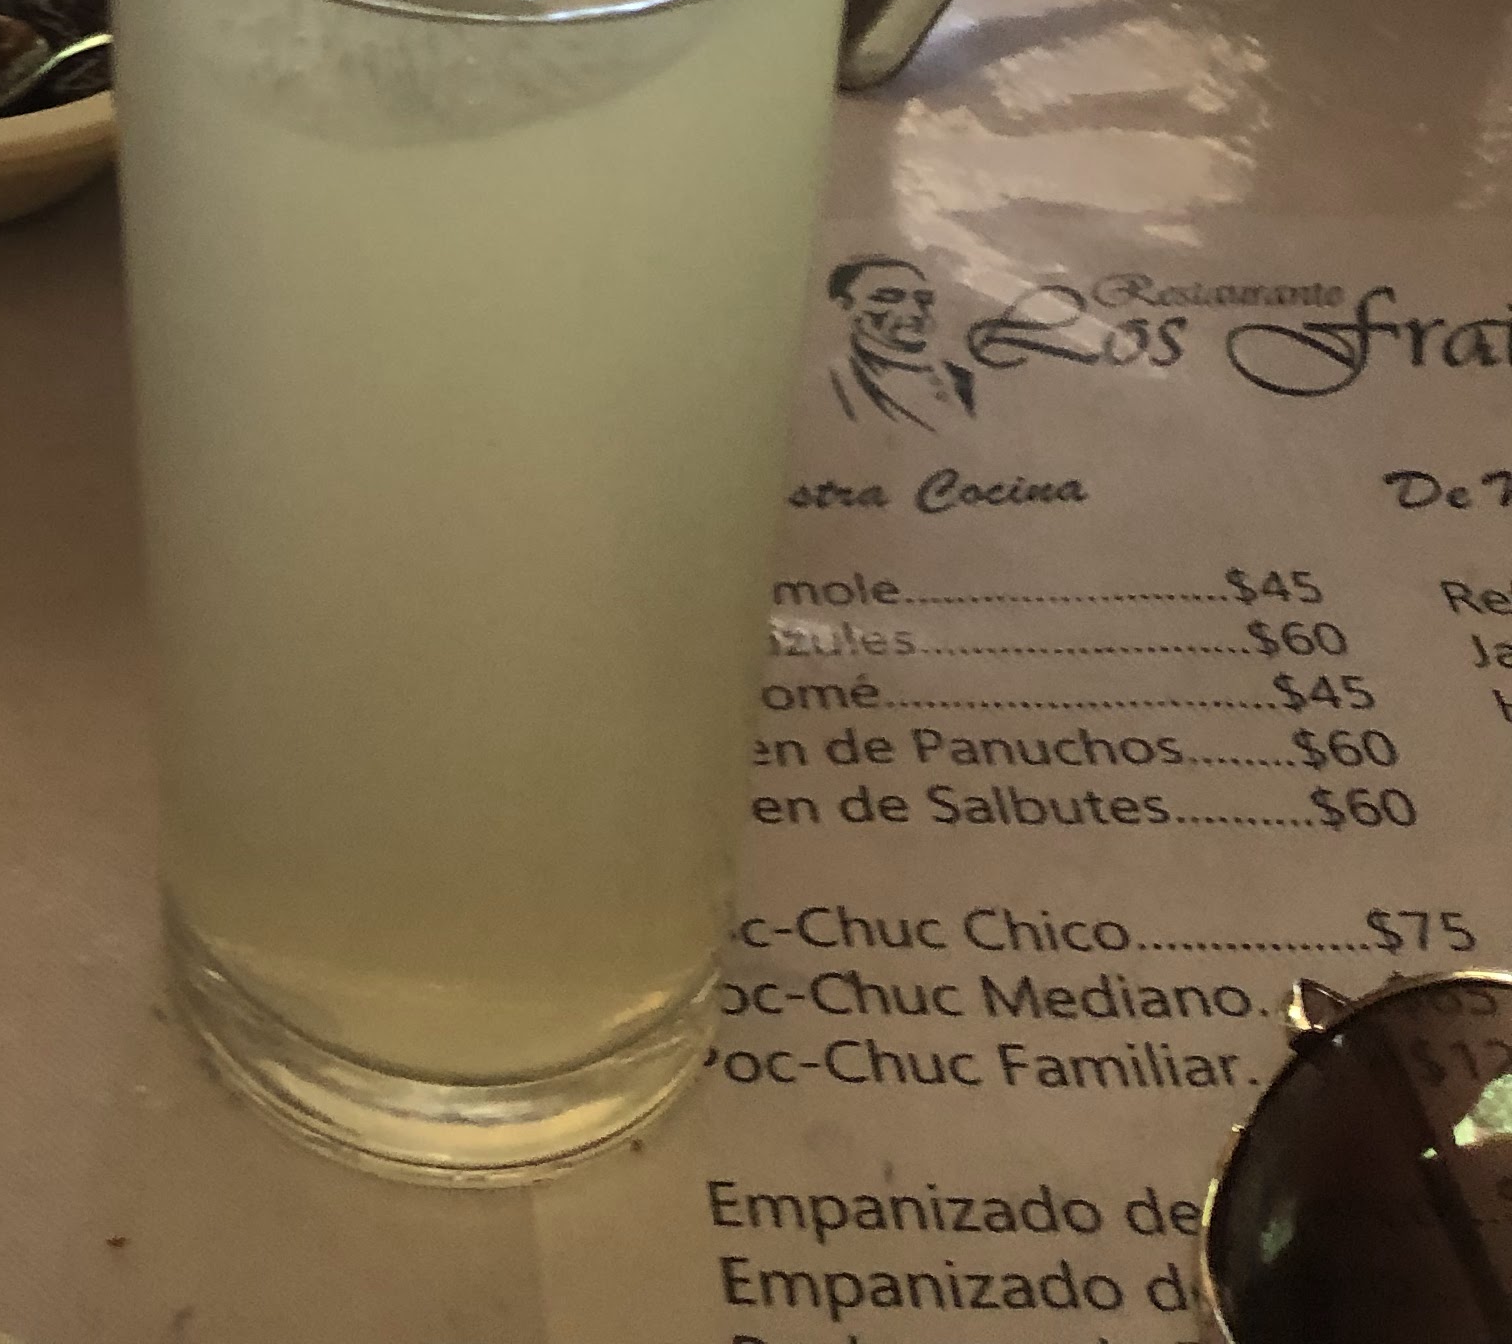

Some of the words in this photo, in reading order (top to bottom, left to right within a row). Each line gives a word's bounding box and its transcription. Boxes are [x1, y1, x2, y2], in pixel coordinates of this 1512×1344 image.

[963, 283, 1188, 370] Los
[913, 466, 1090, 515] Cocina
[1381, 468, 1473, 510] De
[771, 571, 900, 606] mole
[1226, 567, 1324, 606] $45
[1248, 620, 1348, 659] $60
[759, 672, 880, 711] omé
[1273, 673, 1376, 714] $45
[824, 726, 895, 766] de
[910, 727, 1185, 767] Panuchos
[1294, 728, 1399, 772] $60
[751, 796, 821, 825] en
[838, 783, 910, 824] de
[925, 784, 1171, 827] Salbutes
[1311, 787, 1419, 832] $60
[964, 906, 1132, 954] Chico
[1366, 907, 1477, 956] $75
[707, 1179, 1104, 1246] Empanizado
[1125, 1188, 1201, 1237] de
[719, 1257, 1125, 1323] Empanizado
[1146, 1262, 1201, 1313] d
